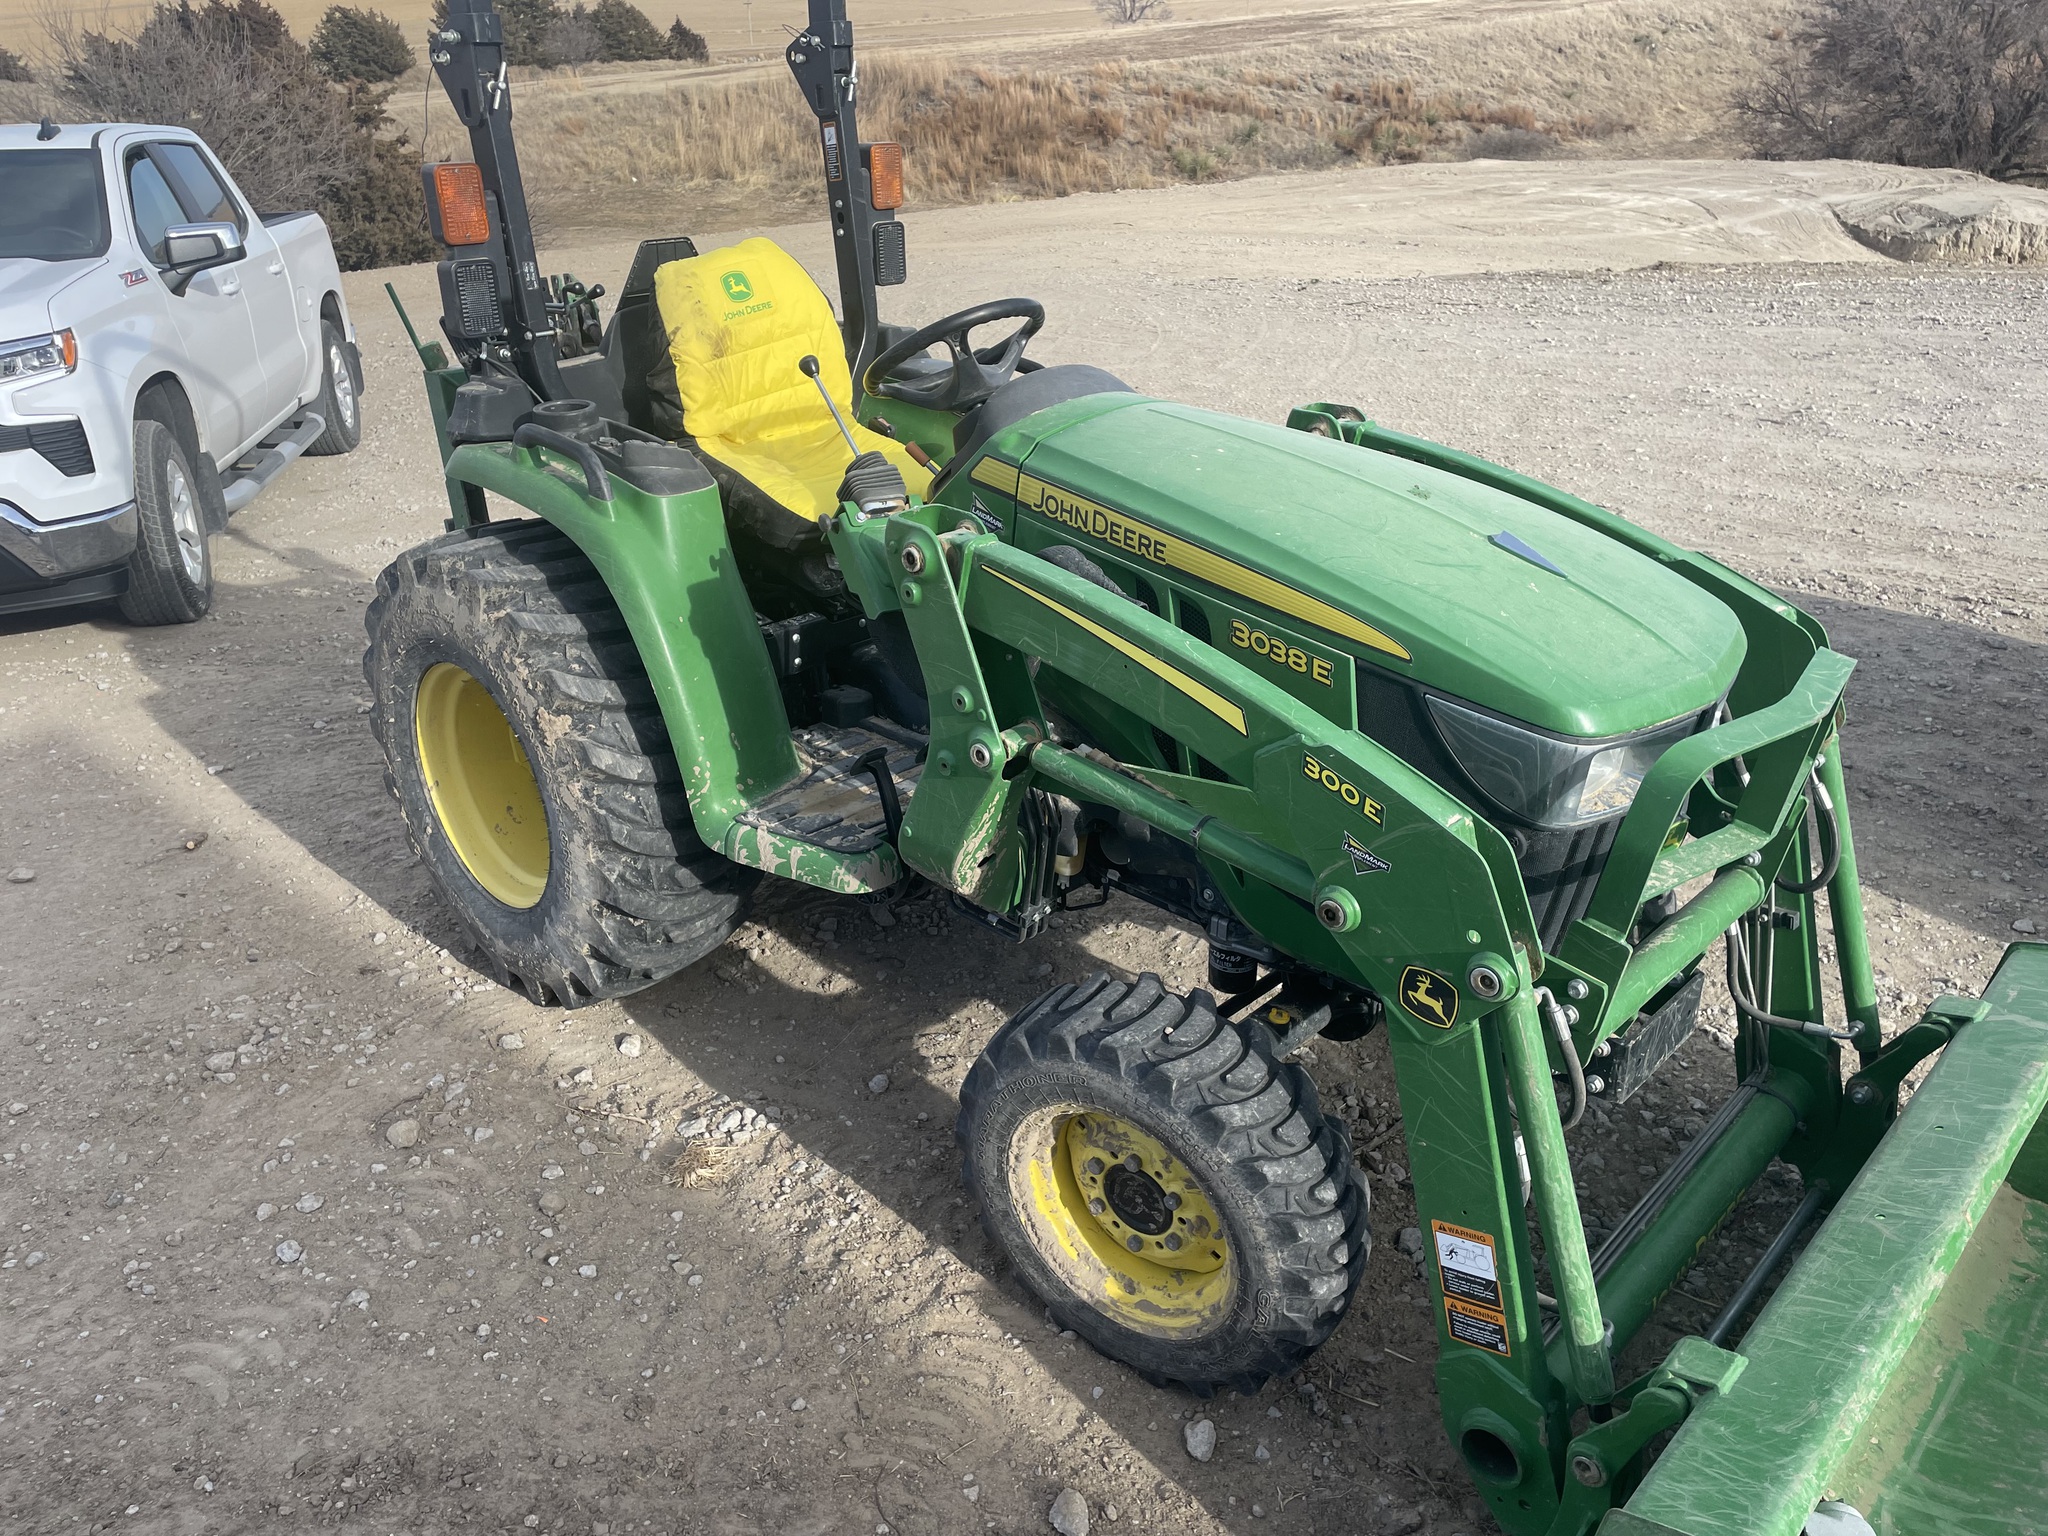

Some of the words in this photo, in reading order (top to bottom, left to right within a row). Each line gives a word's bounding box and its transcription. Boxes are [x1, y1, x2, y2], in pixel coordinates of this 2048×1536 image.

[723, 309, 745, 321] JOHN
[744, 300, 773, 315] DEERE
[1033, 487, 1089, 530] JOHN
[1093, 509, 1167, 562] DEERE
[1344, 843, 1389, 870] LANDMARK
[977, 1072, 1088, 1160] MARATHONER
[1447, 1226, 1486, 1242] WARNING
[1460, 1305, 1499, 1322] WARNING
